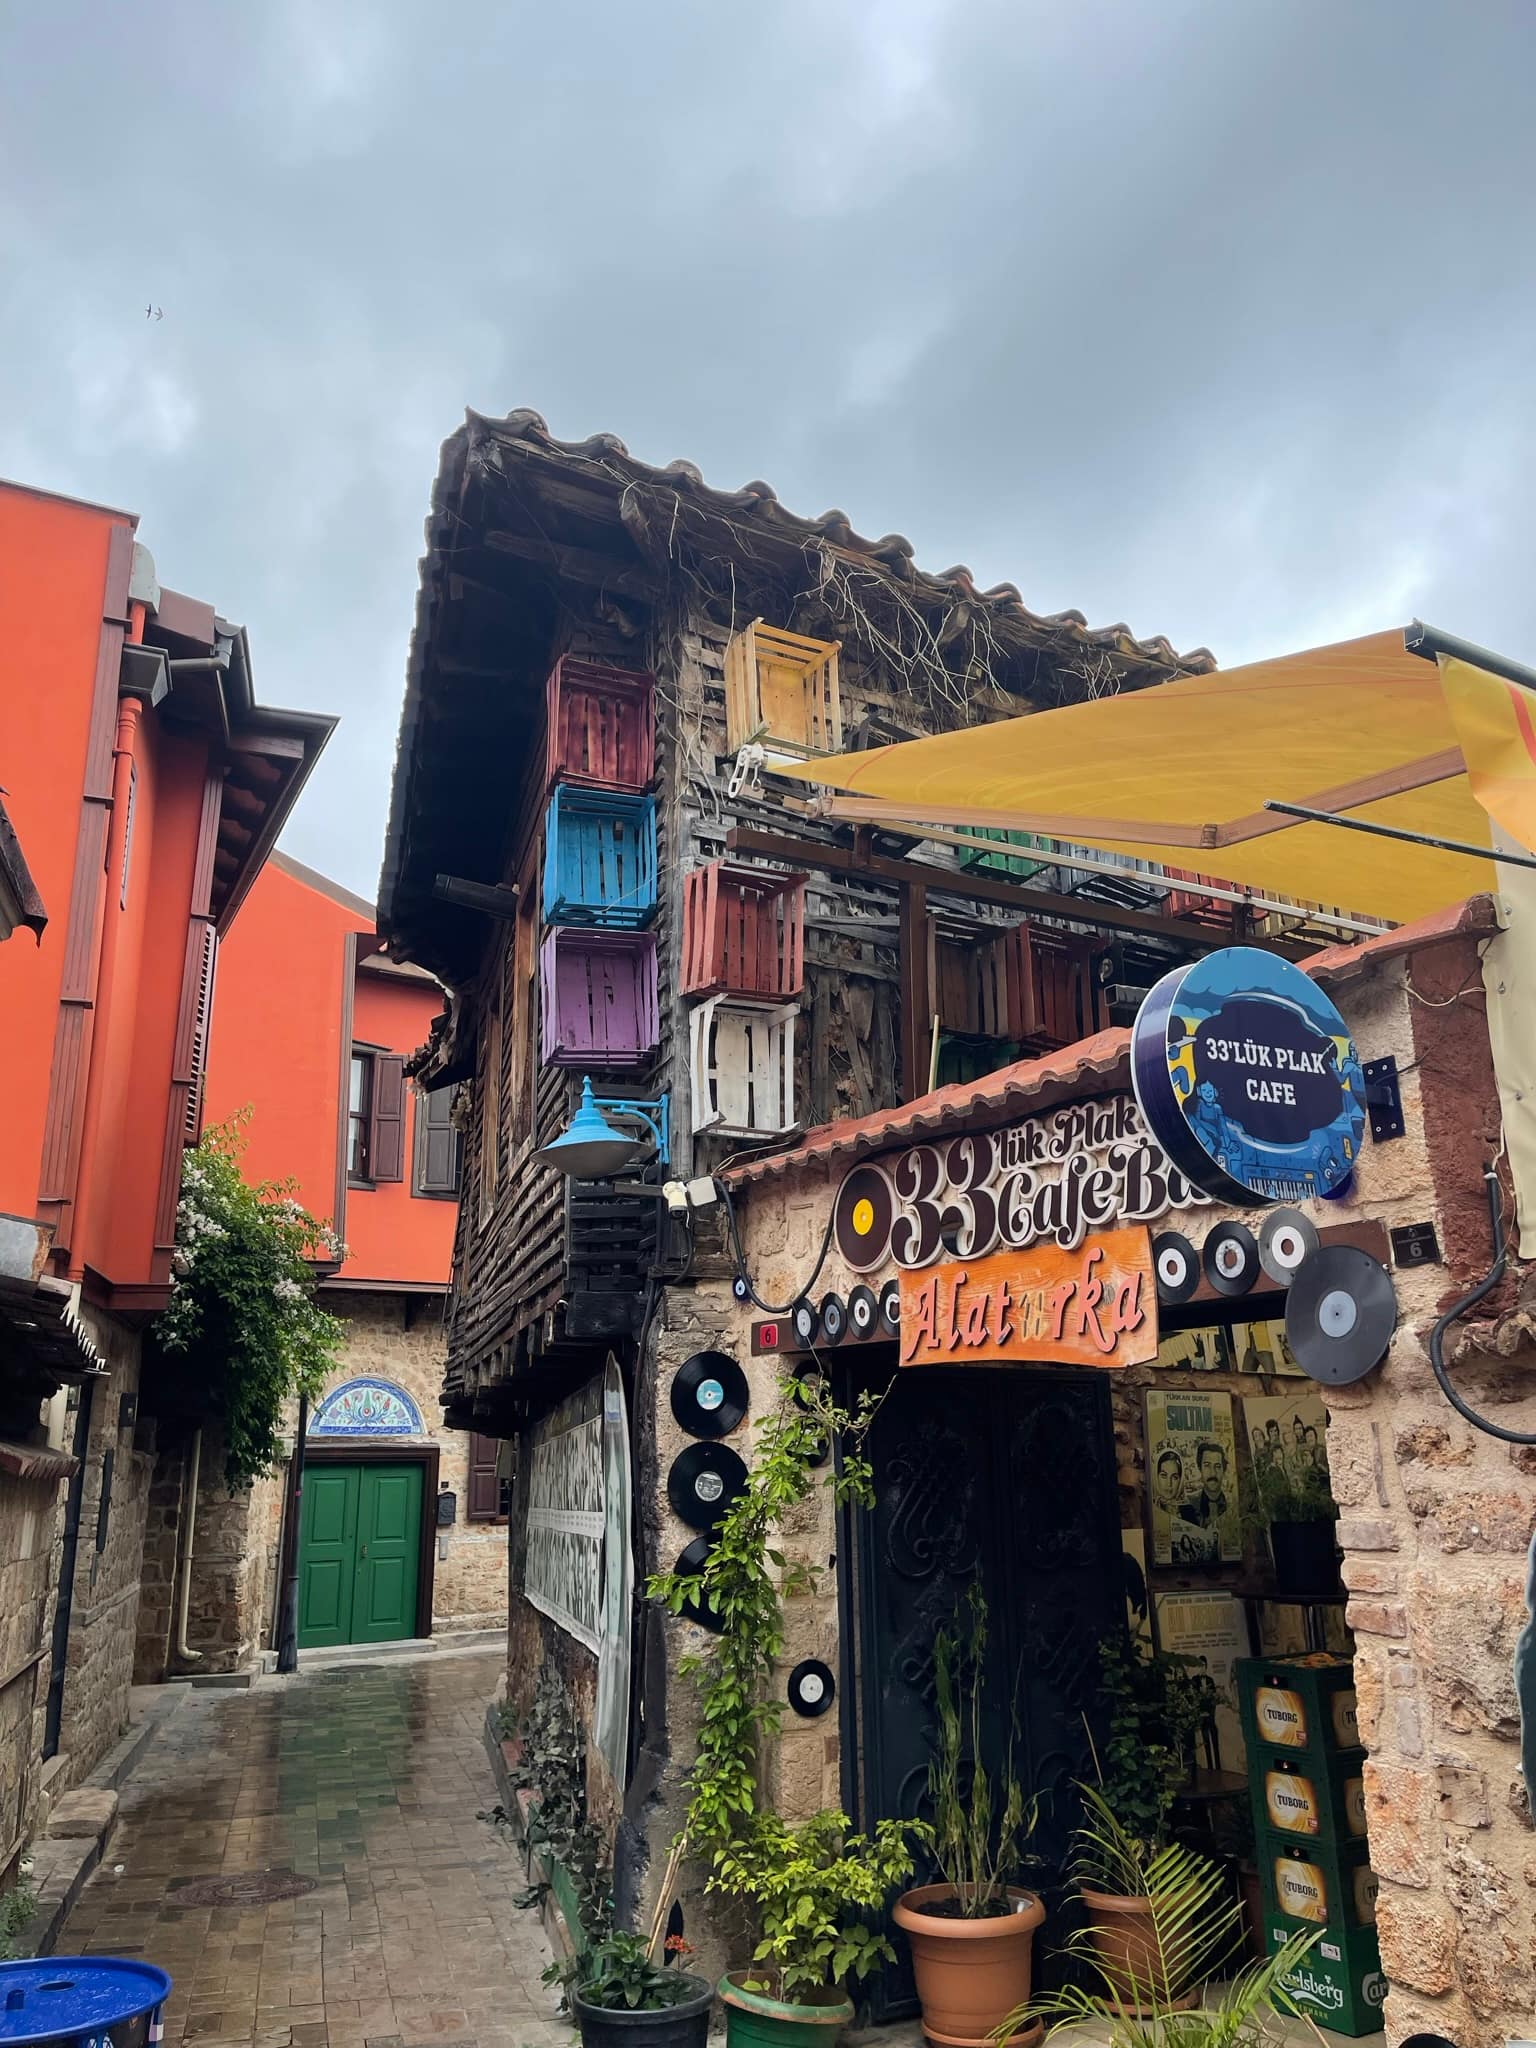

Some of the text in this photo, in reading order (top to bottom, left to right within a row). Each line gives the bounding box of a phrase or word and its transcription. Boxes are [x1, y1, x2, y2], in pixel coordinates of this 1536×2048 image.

[1205, 1037, 1326, 1075] 33'LÜK PLAK
[1246, 1078, 1297, 1106] CAFE
[1048, 1096, 1140, 1161] Plak
[998, 1153, 1117, 1250] Cafe
[1410, 1241, 1423, 1258] 6
[900, 1246, 1145, 1362] Alatrka
[764, 1328, 771, 1344] 6
[1166, 1405, 1213, 1433] SULTAN
[1266, 1708, 1298, 1724] TUBORG
[1277, 1794, 1309, 1811] TUBORG
[1287, 1881, 1318, 1898] TUBORG
